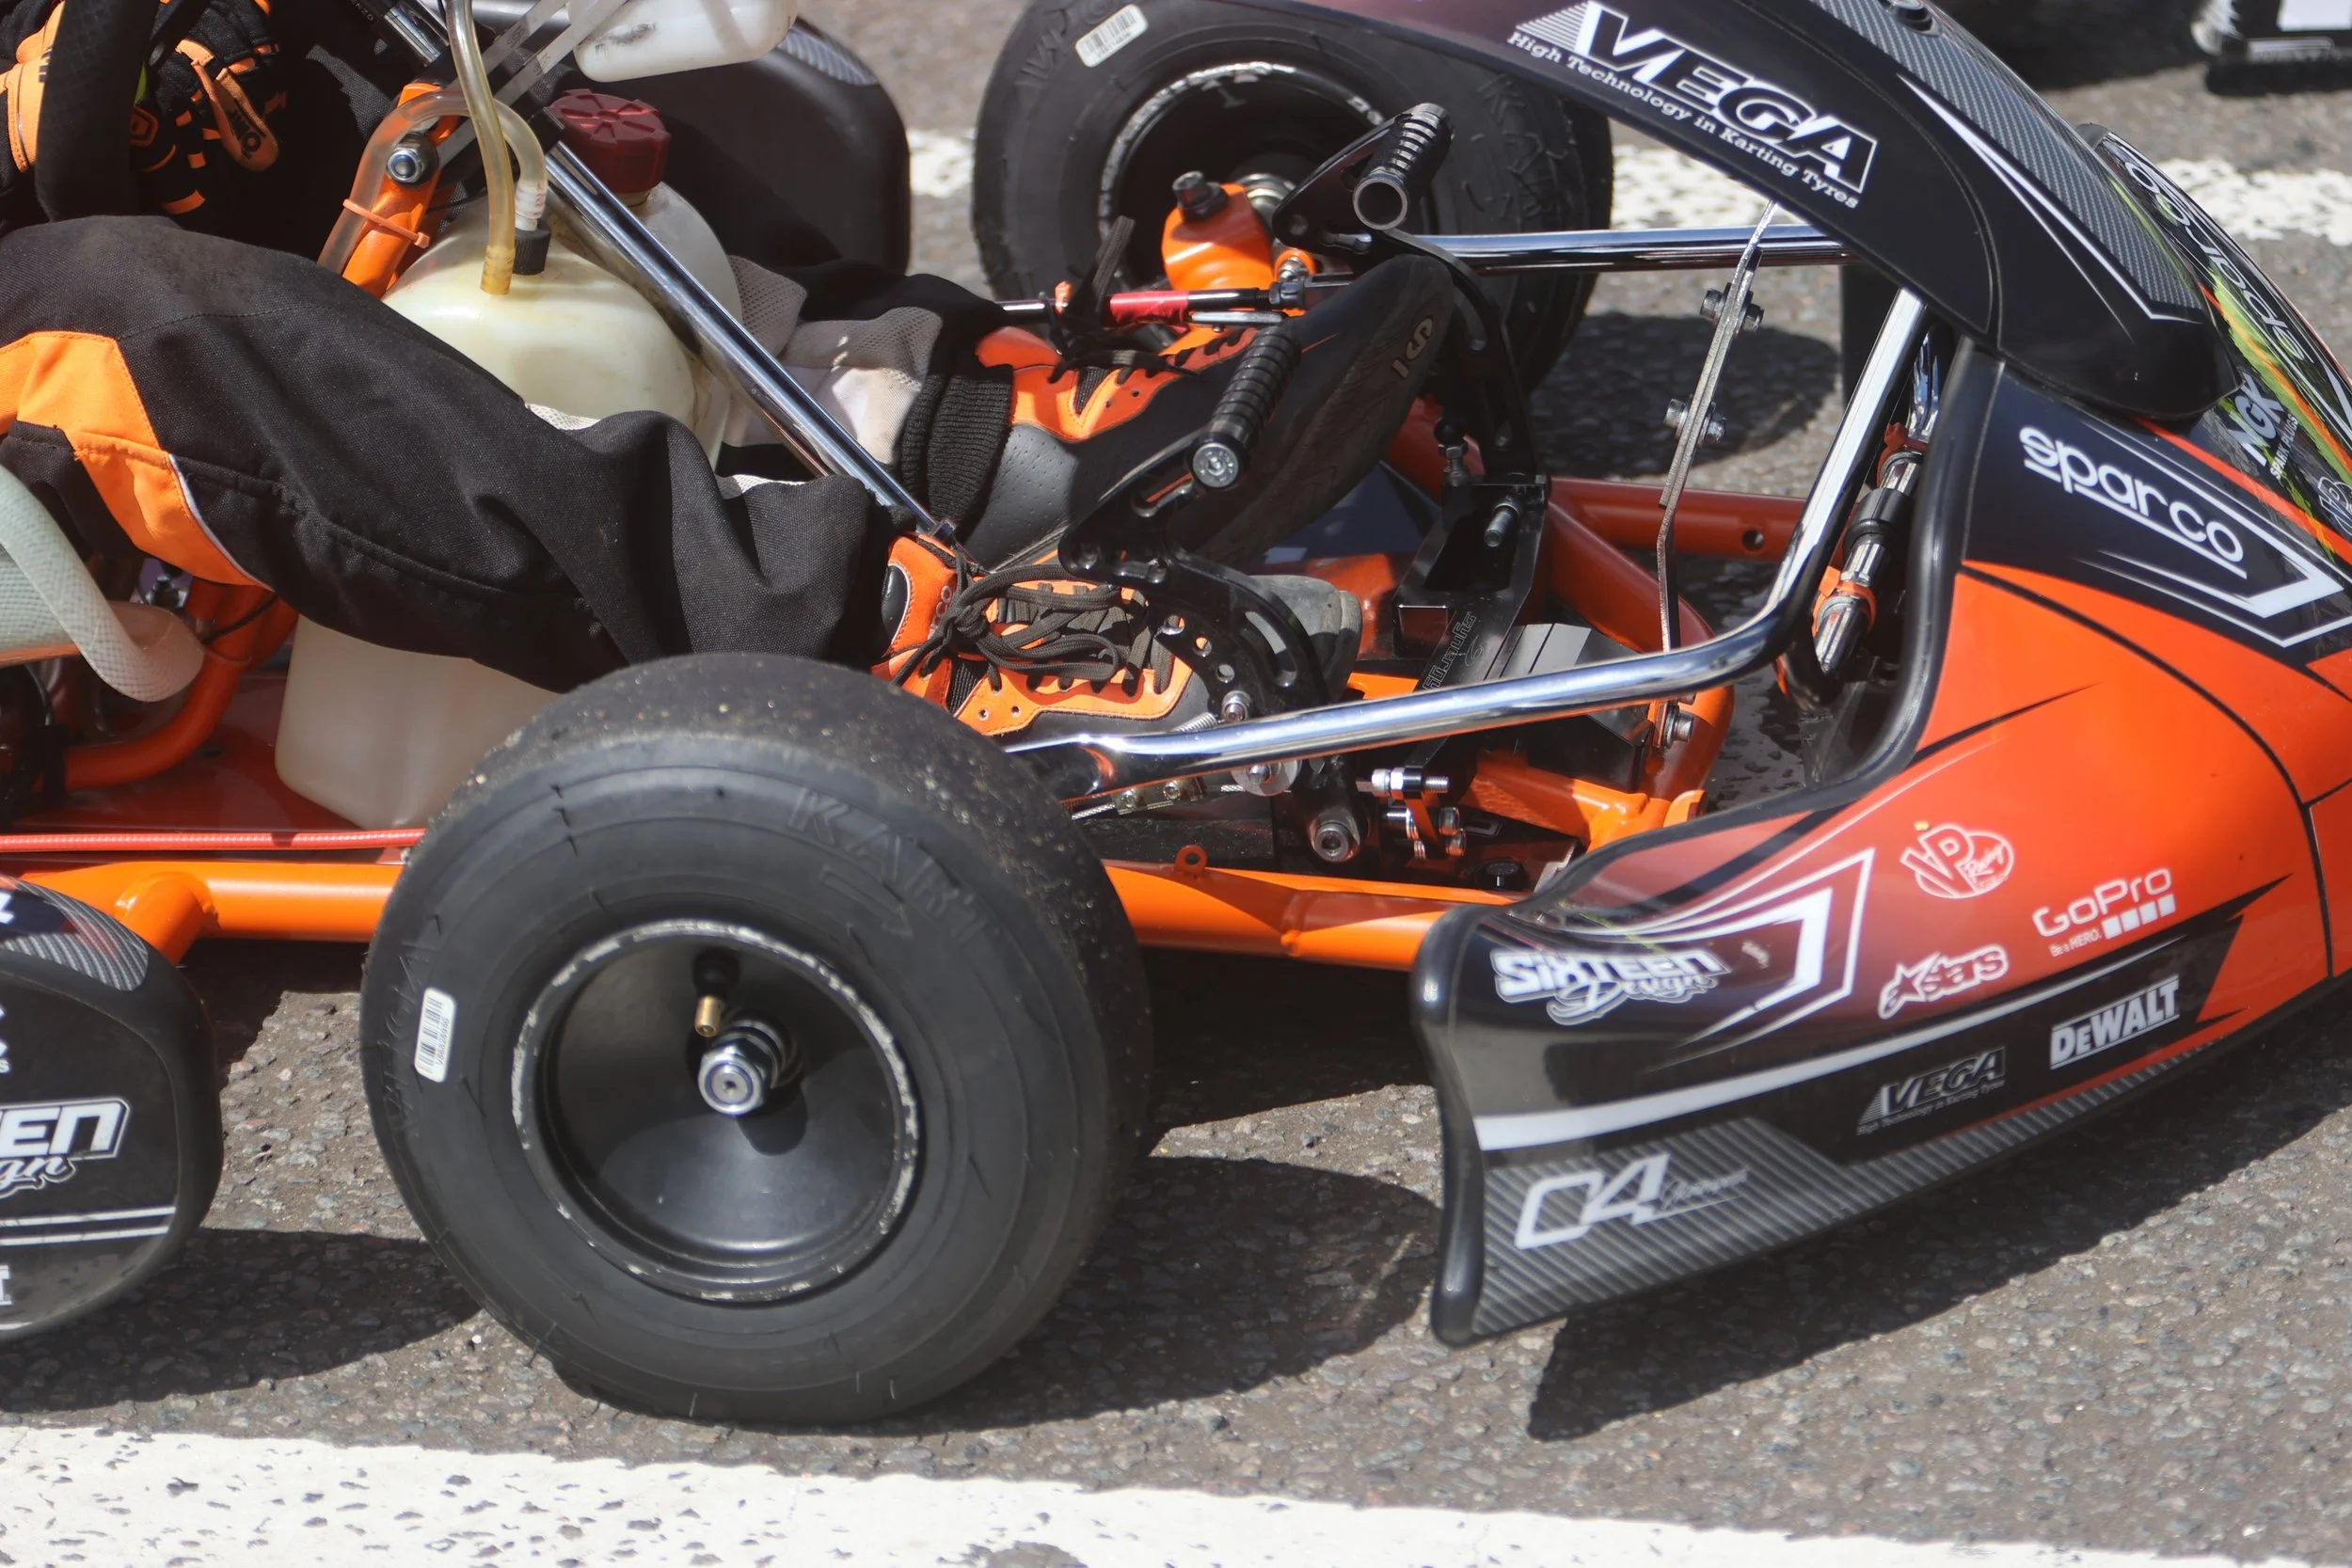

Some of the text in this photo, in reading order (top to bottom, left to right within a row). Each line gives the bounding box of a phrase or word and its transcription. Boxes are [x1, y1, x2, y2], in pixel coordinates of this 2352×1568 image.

[1507, 31, 1859, 209] High Technology in Karting Tyres
[1573, 0, 1878, 195] VEGA
[2019, 426, 2245, 563] sparco
[2032, 867, 2172, 937] GoPro
[1880, 1047, 2006, 1117] VEGA
